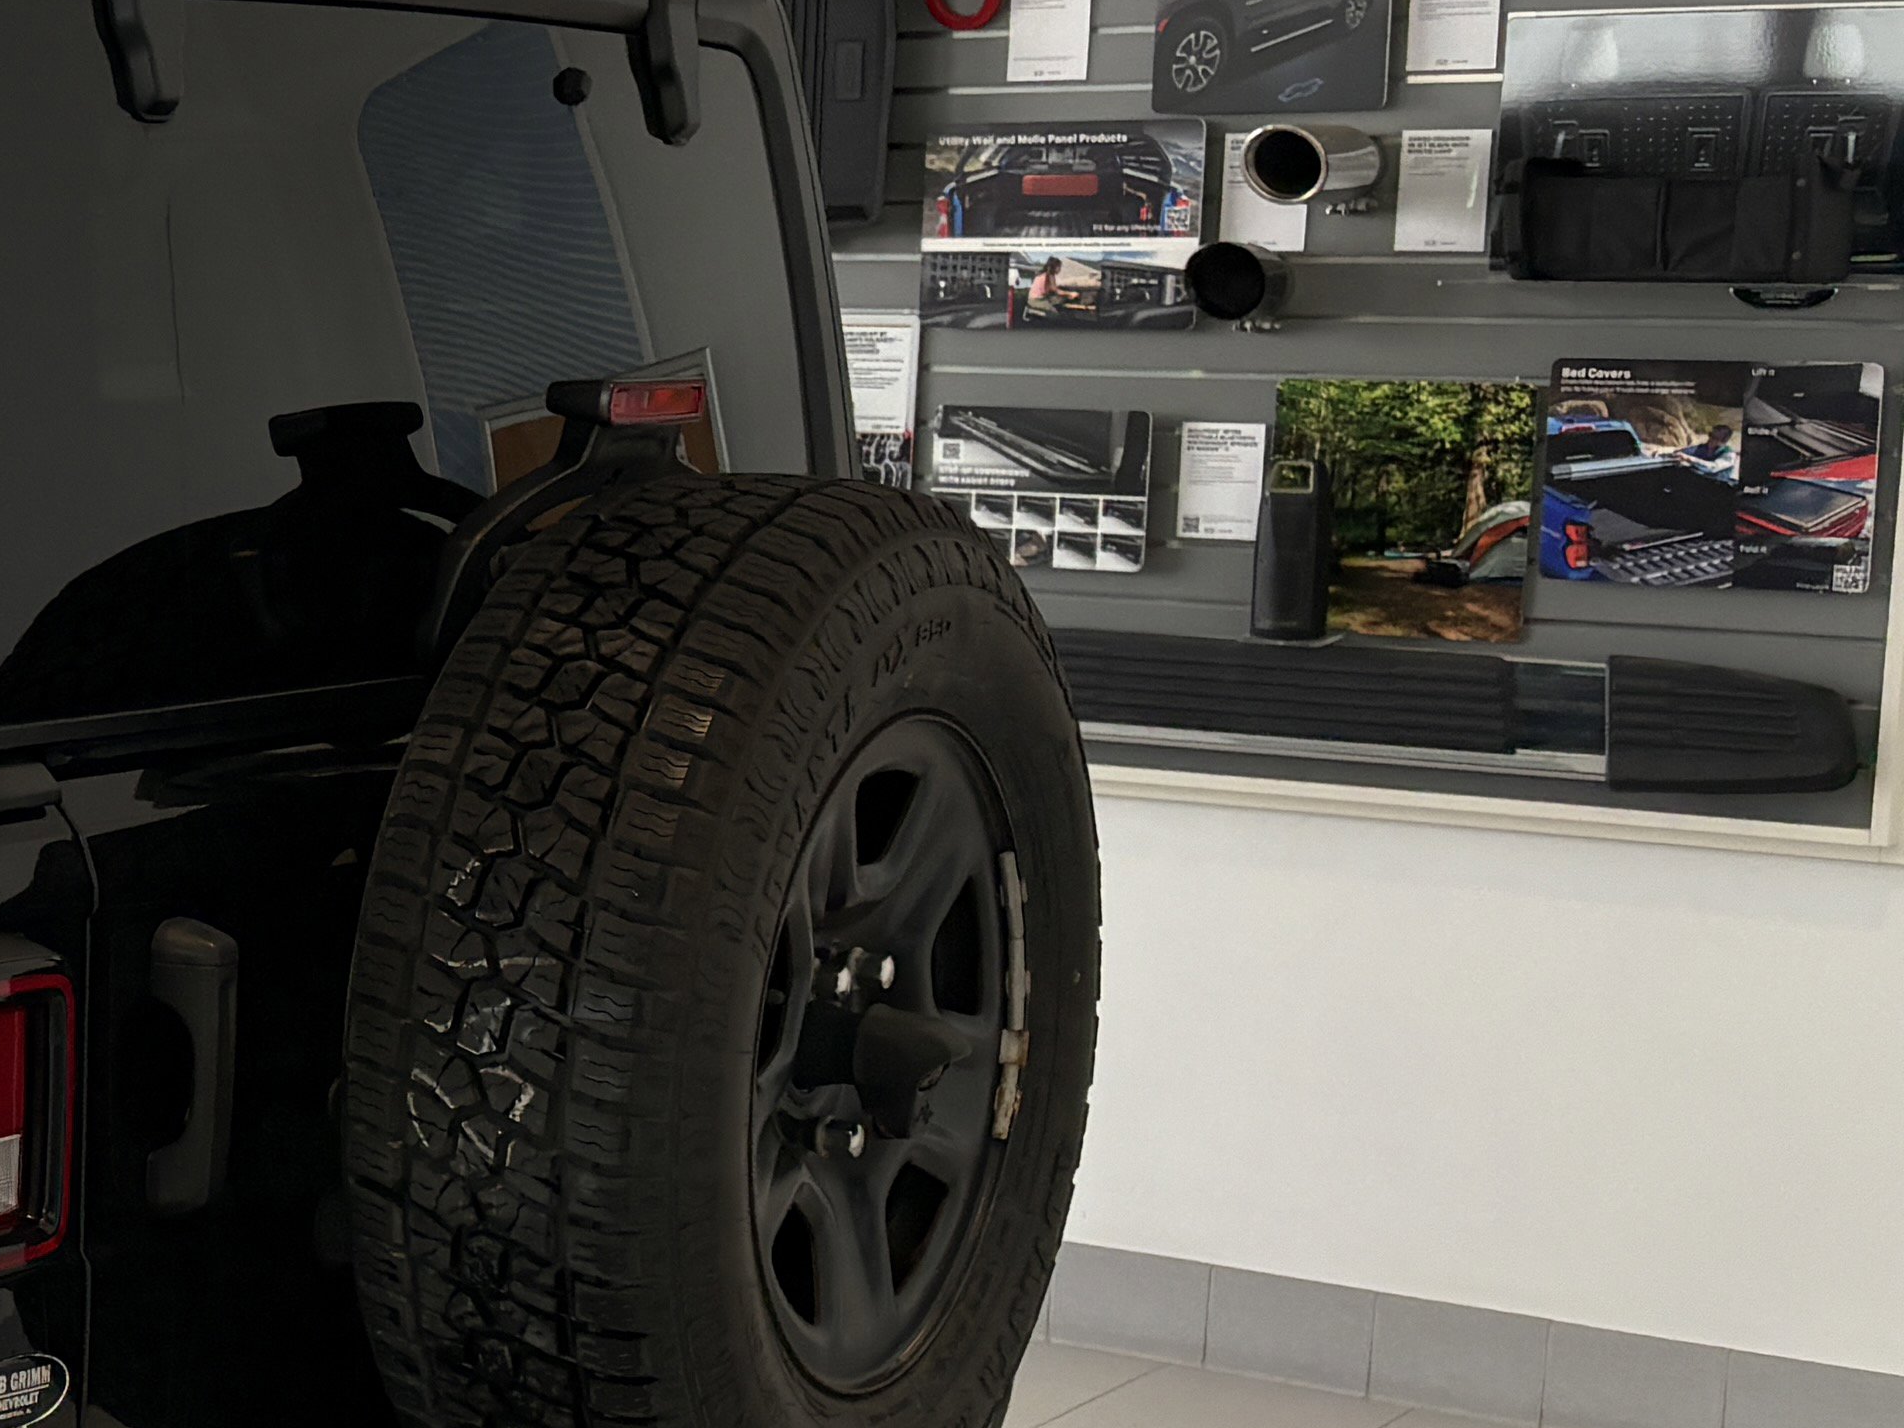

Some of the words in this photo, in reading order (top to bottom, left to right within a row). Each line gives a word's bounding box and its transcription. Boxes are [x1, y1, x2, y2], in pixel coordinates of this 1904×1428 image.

[996, 134, 1016, 145] and
[1048, 133, 1077, 144] Panel
[1079, 132, 1128, 143] Products
[1588, 367, 1631, 379] Covers
[10, 1364, 51, 1391] GRIMM
